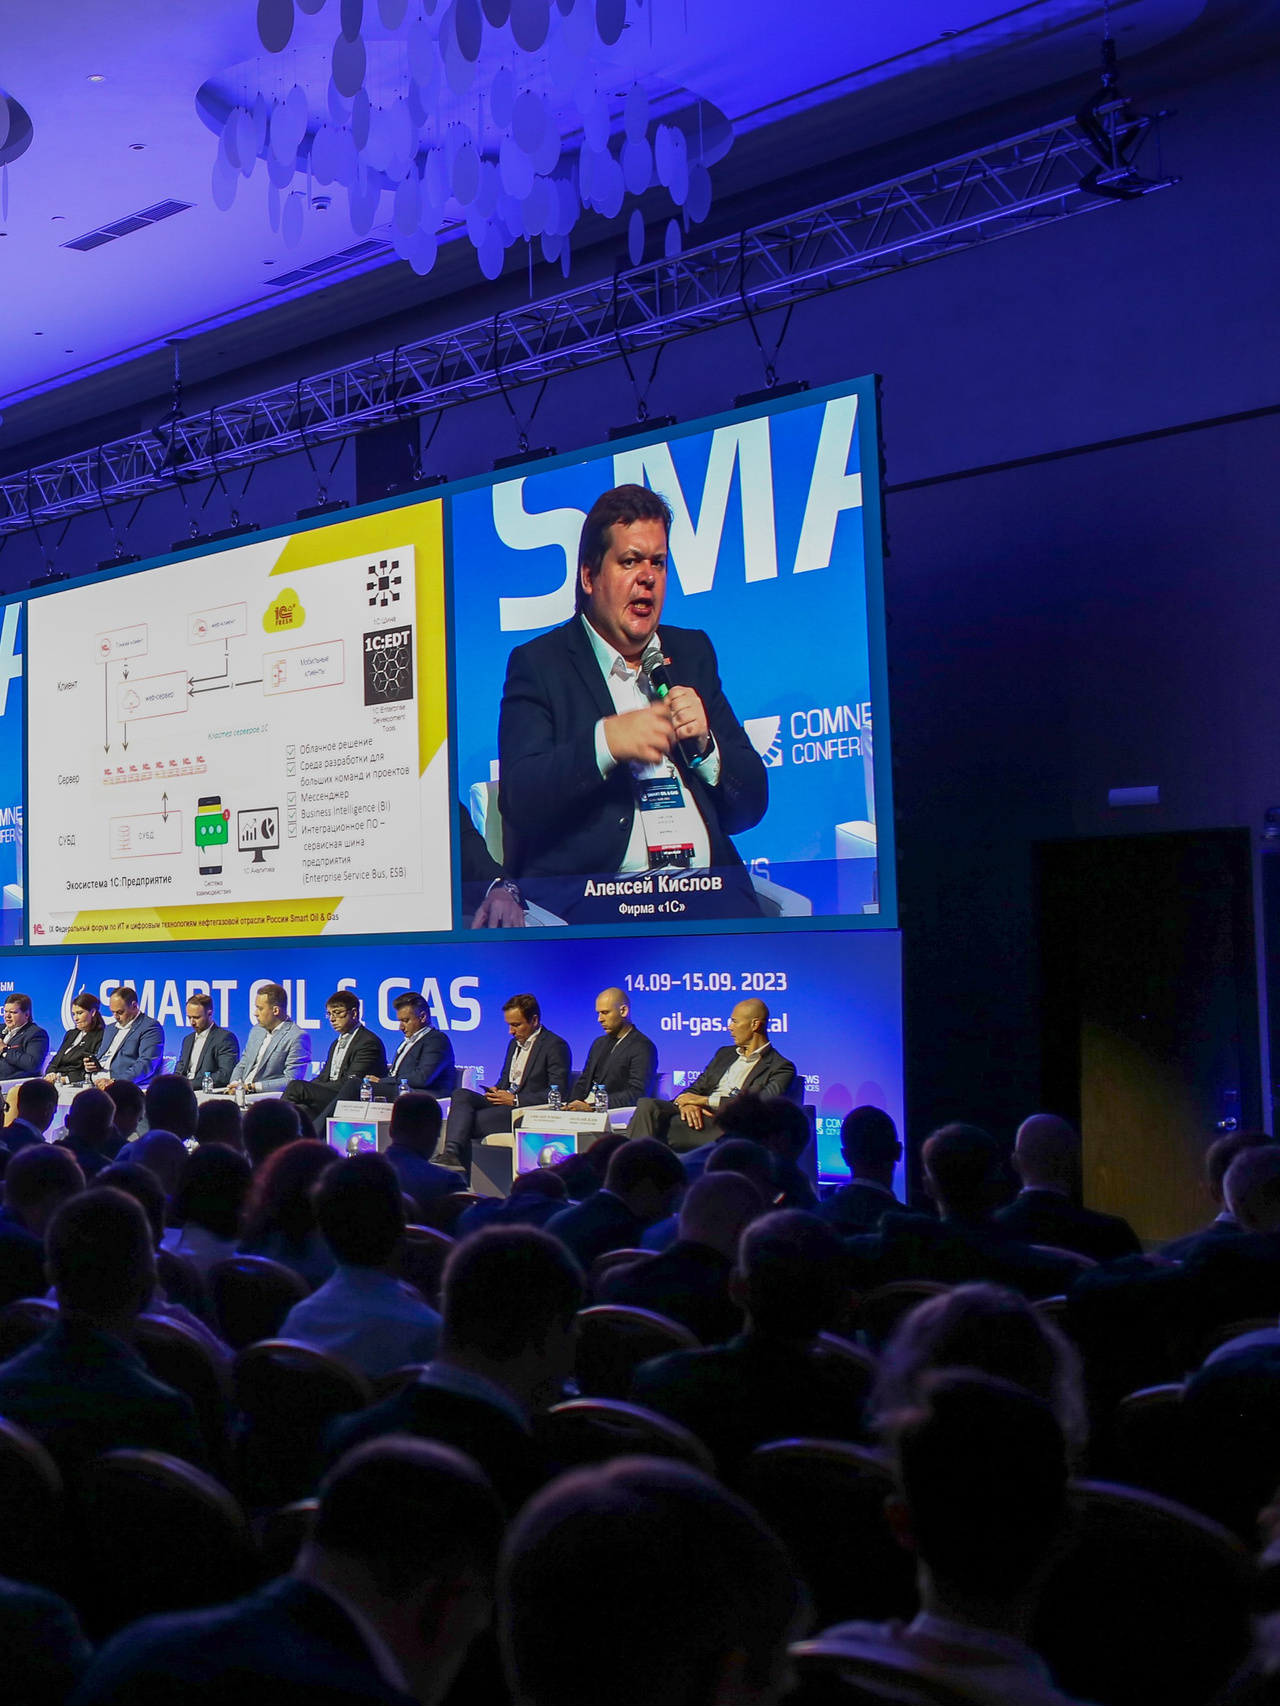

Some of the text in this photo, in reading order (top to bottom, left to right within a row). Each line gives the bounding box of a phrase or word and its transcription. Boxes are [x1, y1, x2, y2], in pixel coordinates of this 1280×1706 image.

[275, 618, 293, 626] FRESH
[365, 630, 410, 652] 1C:EDT
[57, 681, 78, 692] Клиент
[145, 692, 174, 702] web-сервер
[380, 704, 406, 714] Enterprise
[373, 714, 406, 725] Development
[300, 738, 373, 755] Облачное решение
[300, 753, 384, 772] Среда разработки для
[58, 774, 80, 786] Сервер
[301, 776, 332, 787] больших
[334, 772, 364, 783] команд
[373, 766, 410, 779] проектов
[301, 790, 349, 802] Мессенджер
[301, 801, 391, 819] Business Intelligence (BI)
[302, 822, 365, 835] Интеграционное
[366, 819, 378, 829] ПО
[58, 835, 76, 847] СУБД
[139, 832, 154, 840] СУБД
[304, 839, 365, 851] сервисная шина
[302, 856, 351, 867] предприятия
[302, 866, 407, 885] (Enterprise Service Bus, ESB)
[66, 877, 108, 891] Экосистема
[584, 875, 723, 897] Алексей Кислов
[619, 901, 654, 917] Фирма
[55, 924, 90, 934] Федеральный
[91, 923, 109, 934] форум
[117, 922, 125, 930] ИТ
[130, 921, 161, 931] цифровым
[161, 919, 197, 929] технологиям
[198, 917, 239, 928] нефтегазовой
[240, 917, 265, 926] отрасли
[266, 915, 289, 923] России
[290, 913, 309, 922] Smart
[310, 913, 319, 921] Oil
[326, 912, 339, 921] Gas
[741, 972, 788, 992] 2023
